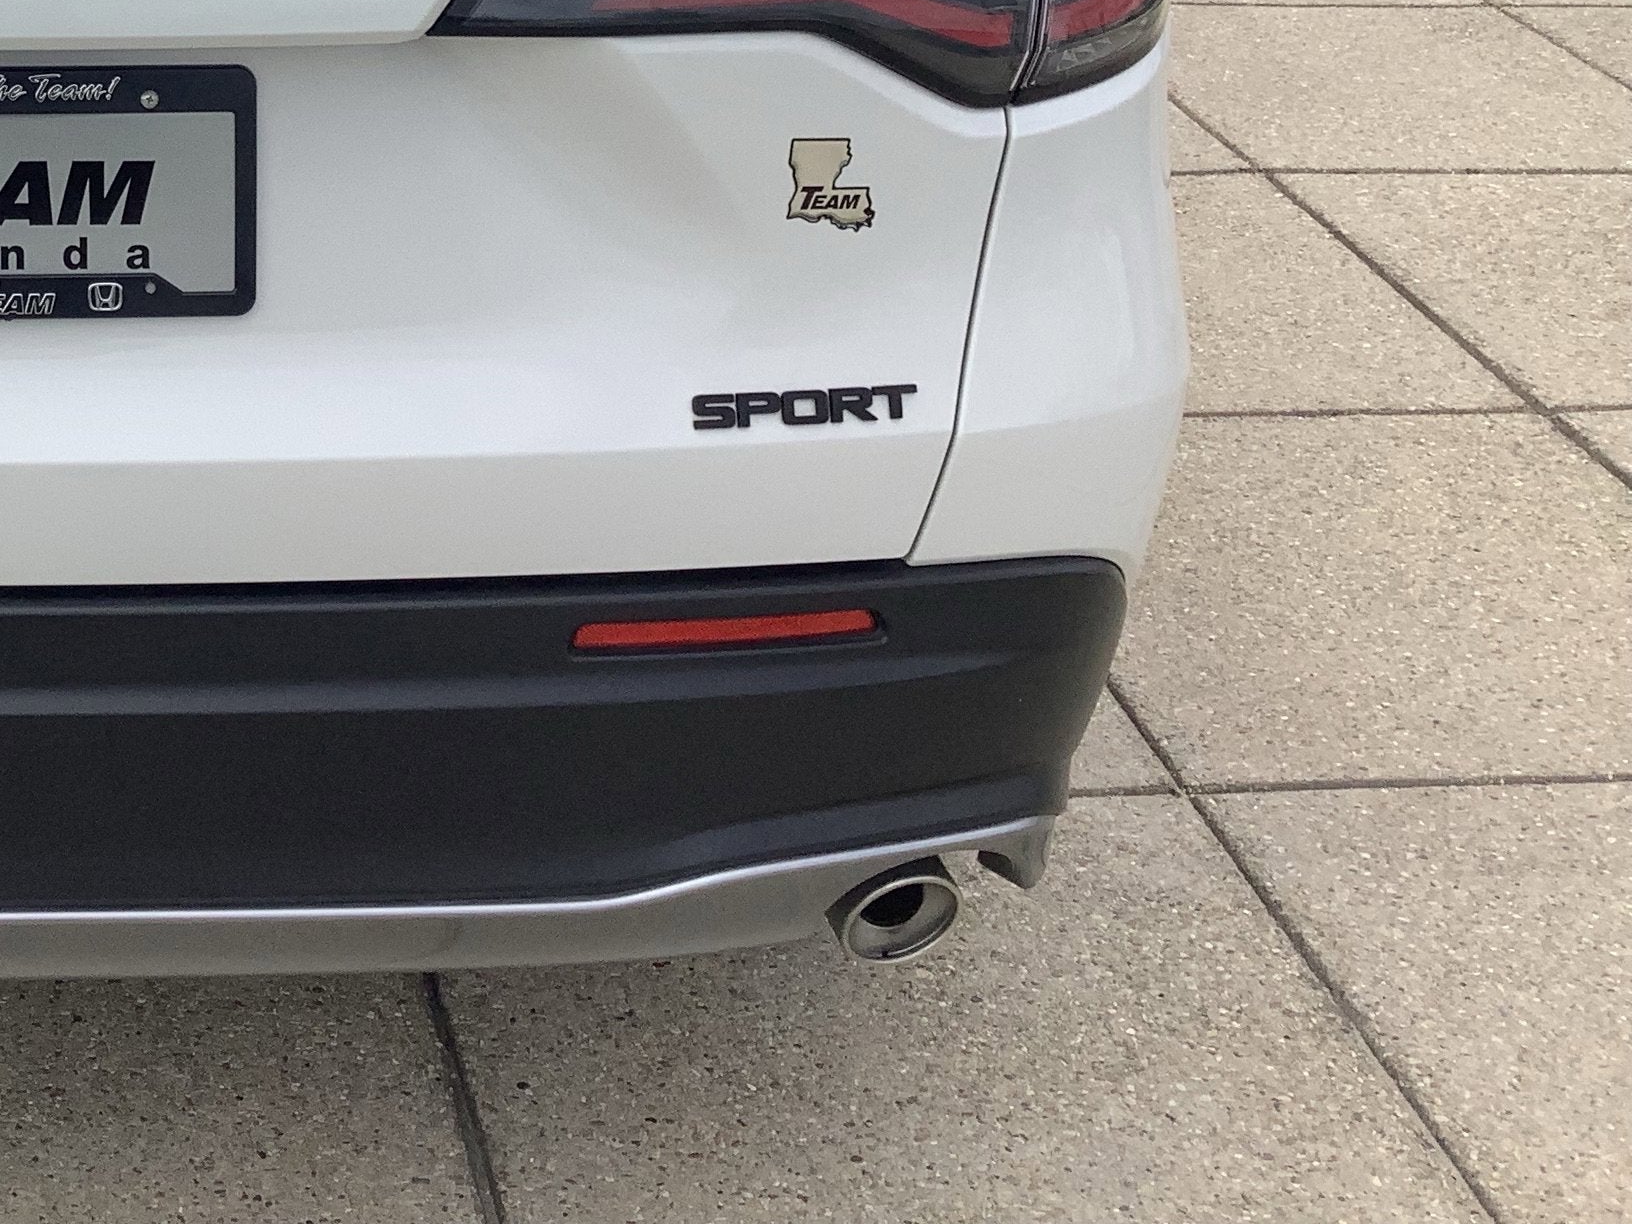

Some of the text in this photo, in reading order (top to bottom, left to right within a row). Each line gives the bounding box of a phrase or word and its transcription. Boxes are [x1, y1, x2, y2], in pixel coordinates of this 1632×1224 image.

[28, 73, 121, 103] Team!
[800, 185, 861, 210] TEAM
[692, 384, 917, 430] SPORT
